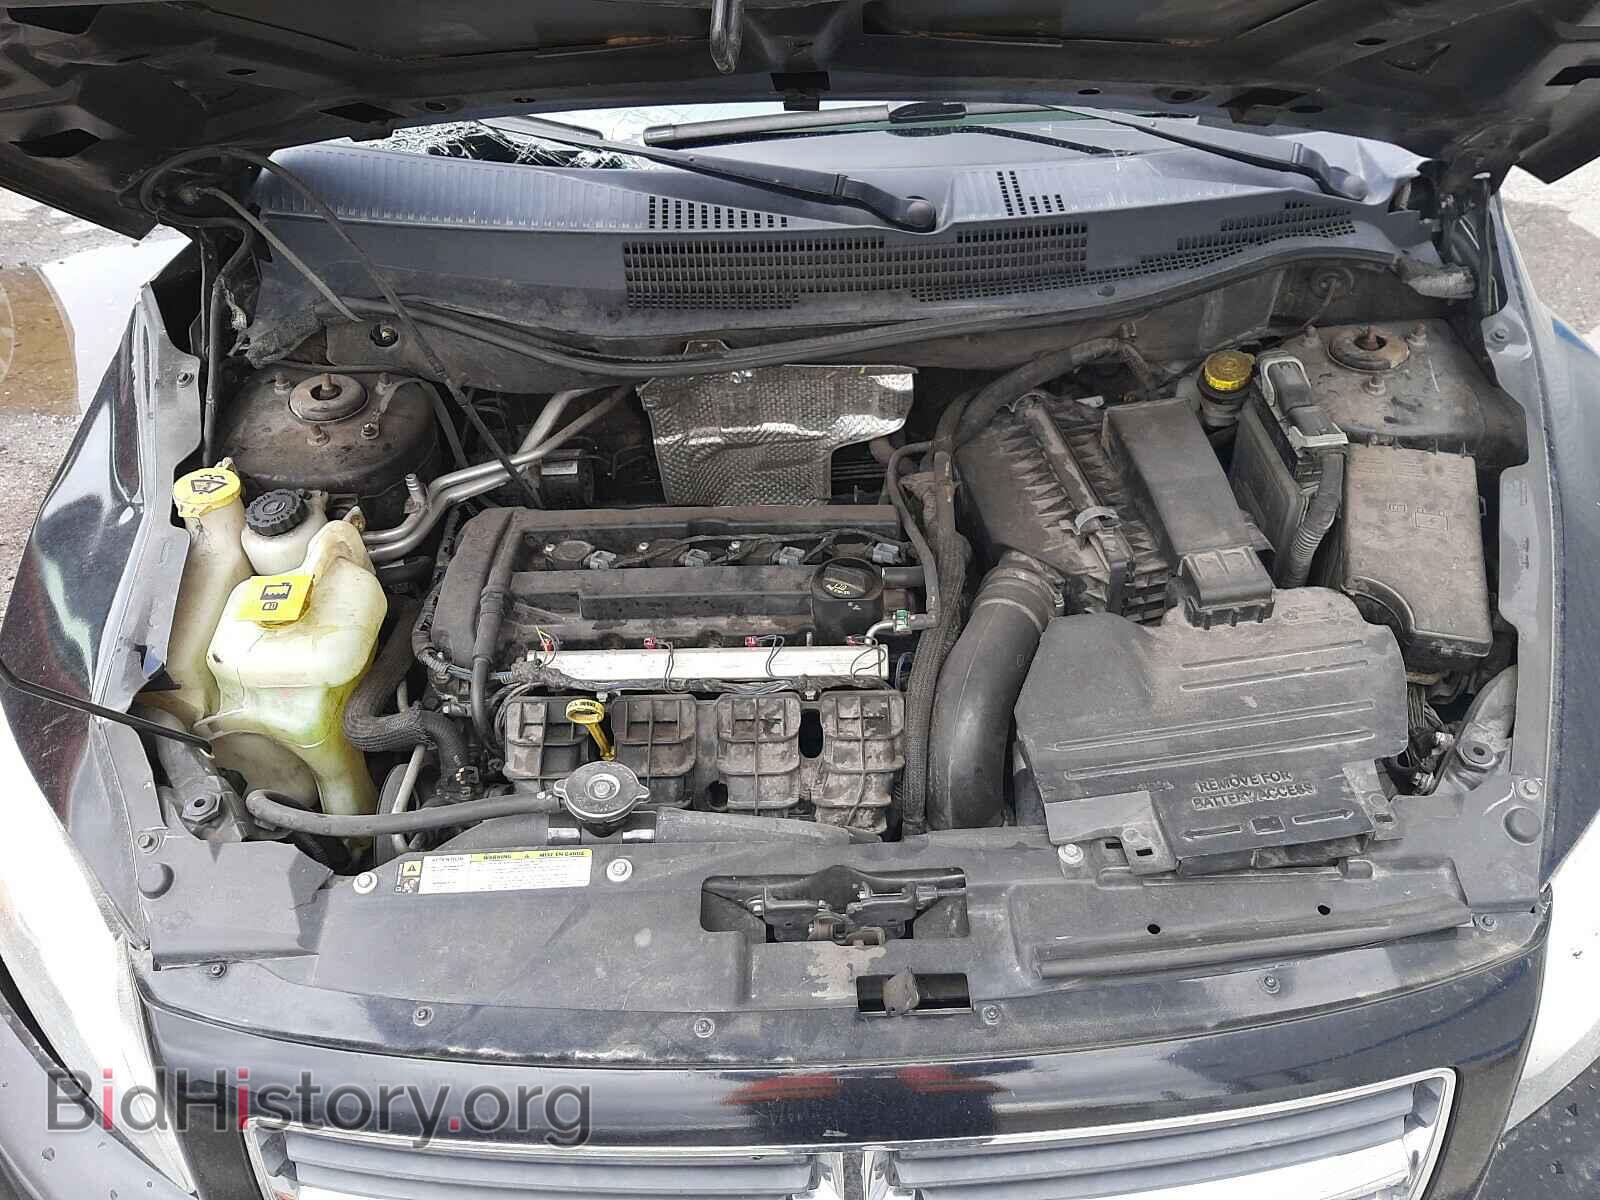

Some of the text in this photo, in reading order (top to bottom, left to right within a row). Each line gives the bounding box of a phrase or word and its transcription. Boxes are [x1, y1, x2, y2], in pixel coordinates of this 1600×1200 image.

[1198, 771, 1292, 792] REMOVE FOR
[1192, 783, 1315, 810] BATTERY ACCESS
[483, 853, 512, 861] WARNING
